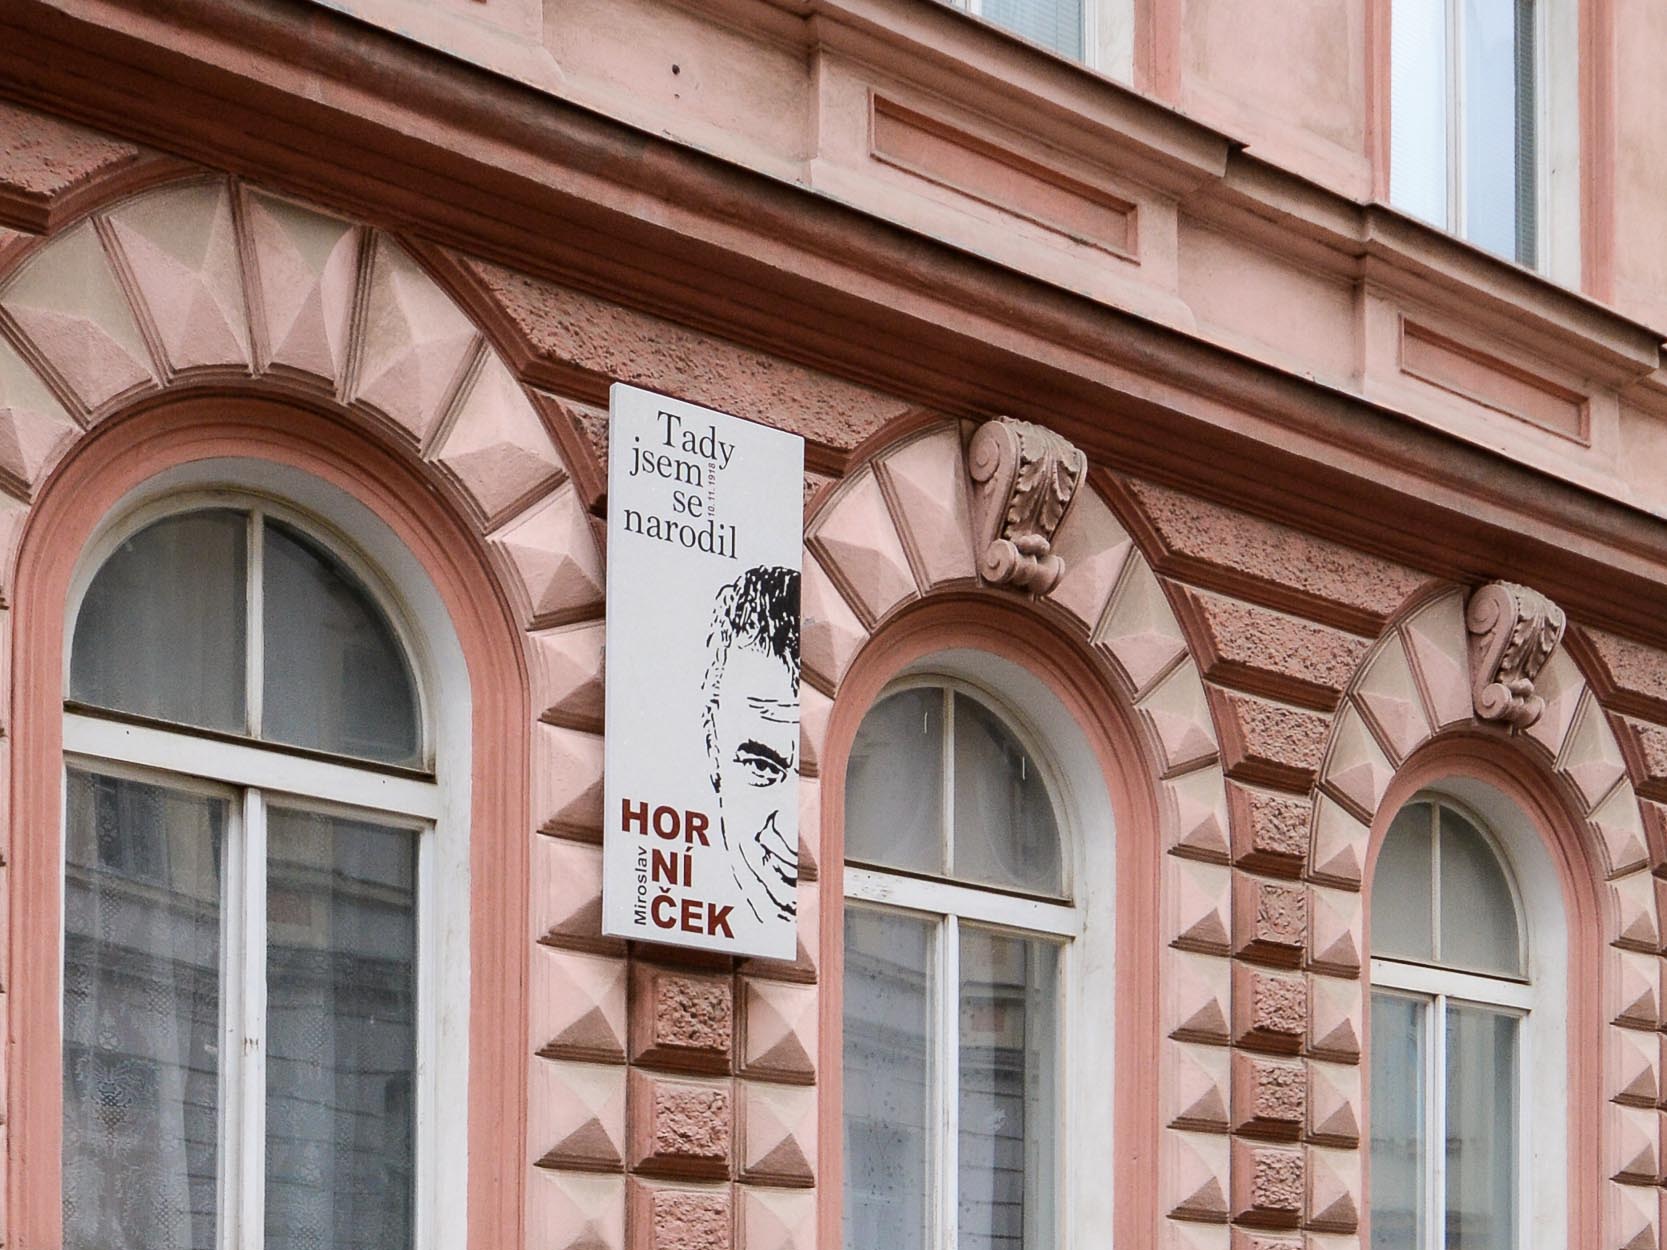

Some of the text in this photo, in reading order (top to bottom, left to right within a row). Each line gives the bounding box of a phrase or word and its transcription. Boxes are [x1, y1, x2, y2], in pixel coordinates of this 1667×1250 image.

[629, 436, 704, 488] jsem
[657, 411, 735, 470] Tady
[673, 490, 703, 518] se
[624, 508, 738, 560] narodil
[621, 798, 710, 847] HOR
[634, 845, 648, 926] Miroslav
[651, 846, 694, 888] NÍ
[650, 886, 735, 939] ČEK
